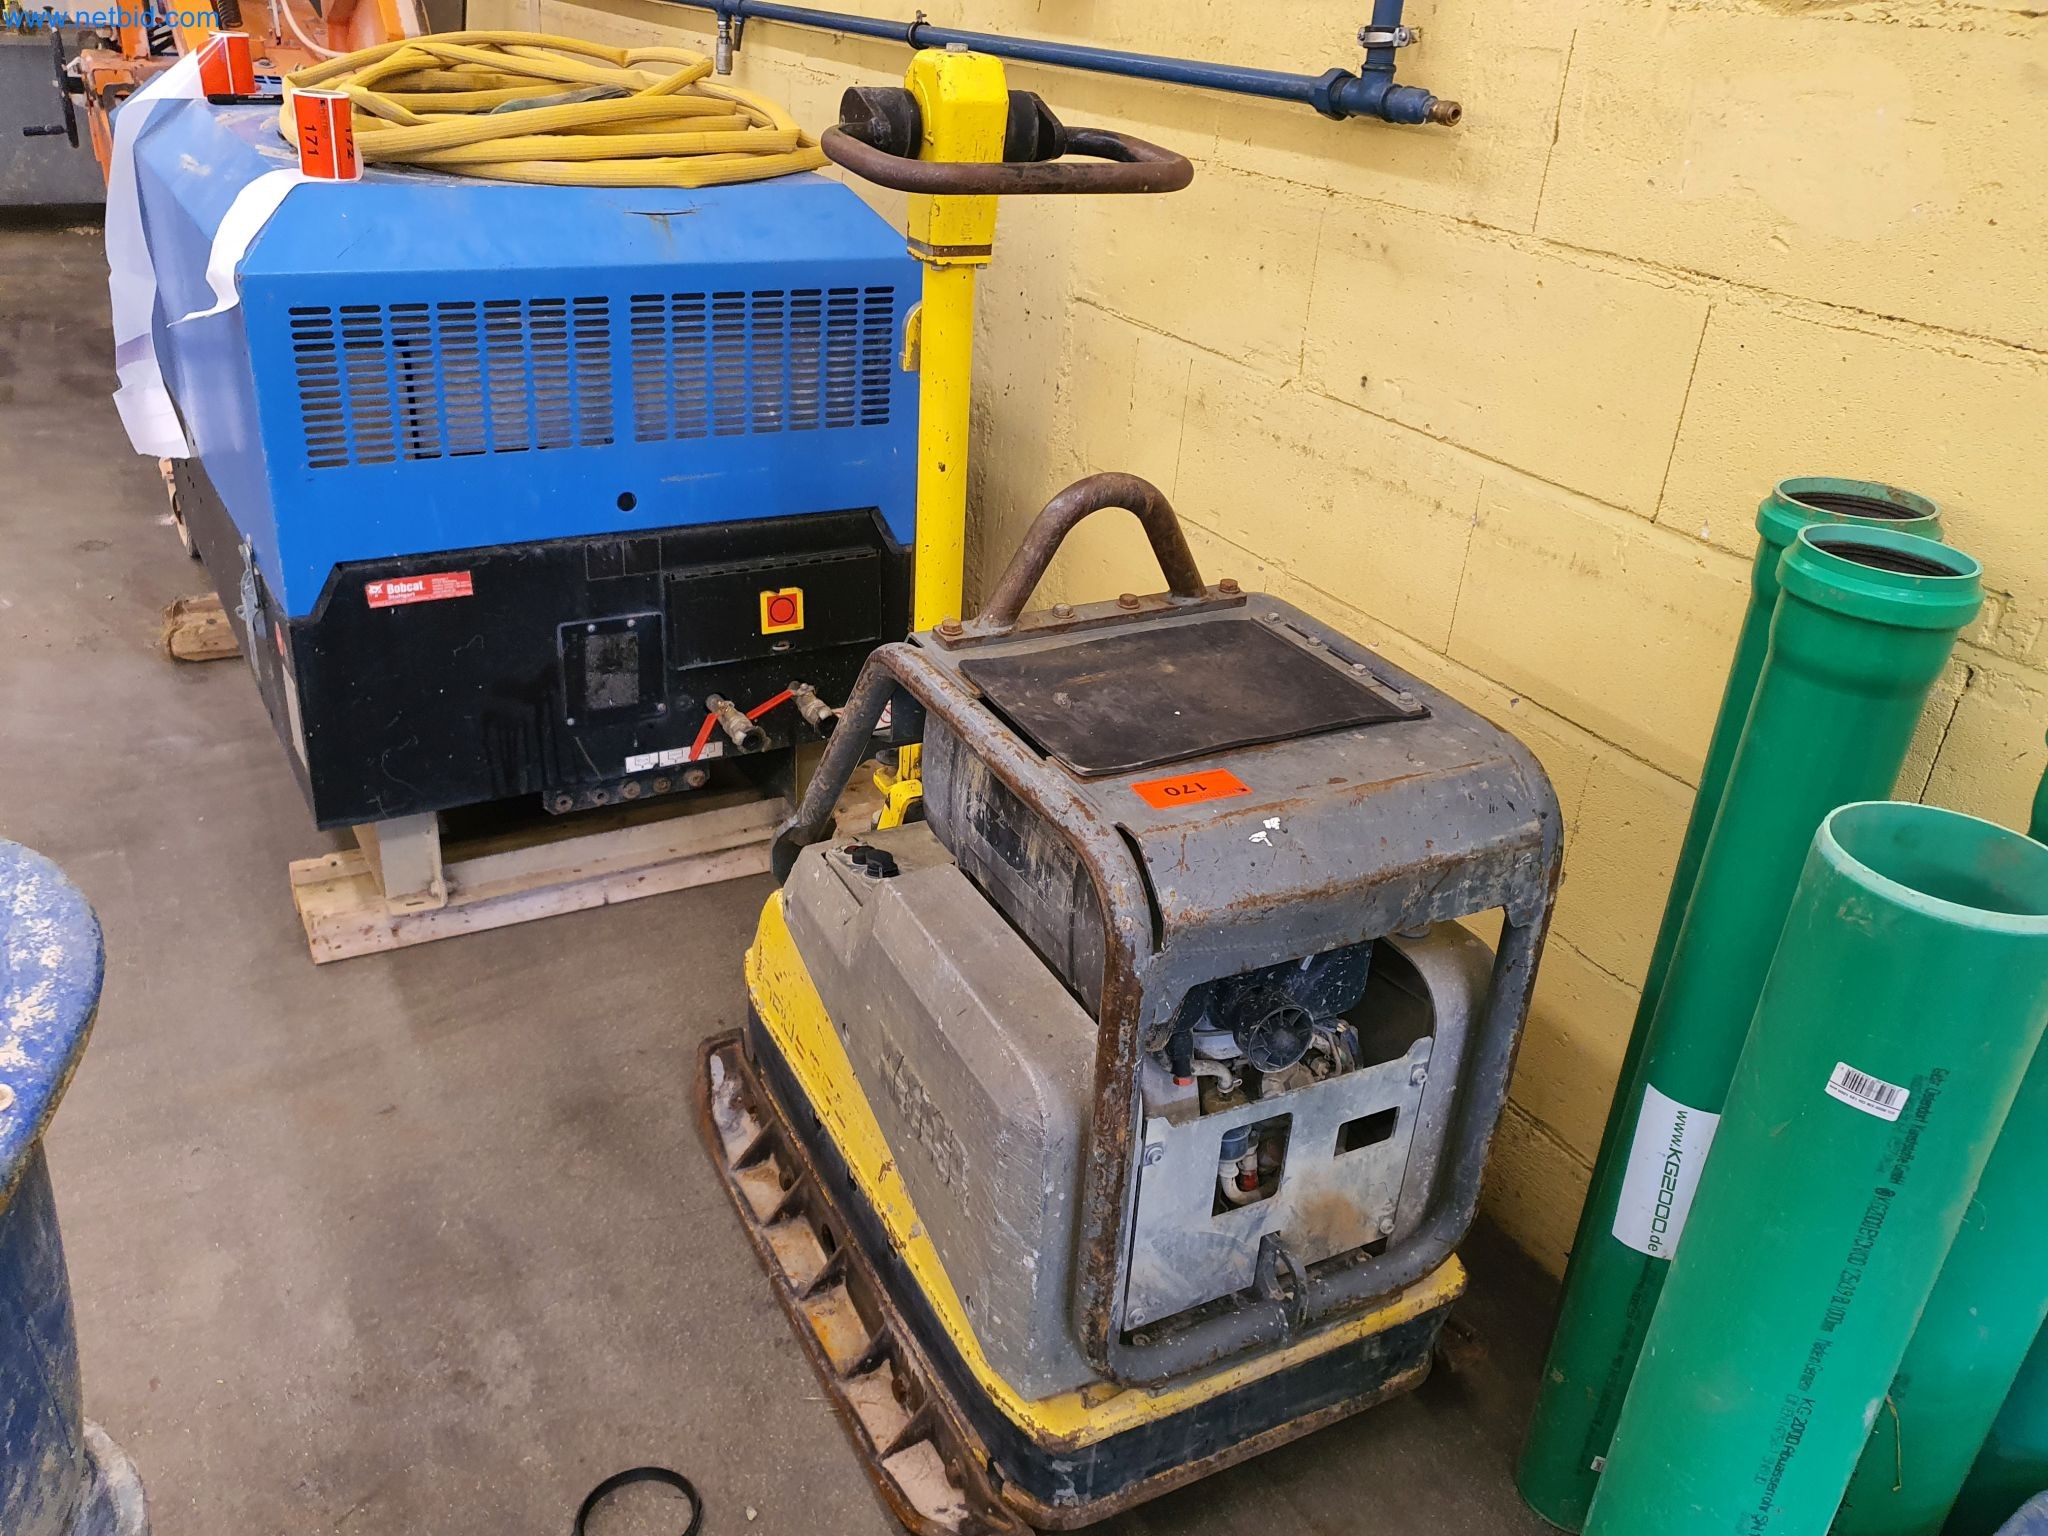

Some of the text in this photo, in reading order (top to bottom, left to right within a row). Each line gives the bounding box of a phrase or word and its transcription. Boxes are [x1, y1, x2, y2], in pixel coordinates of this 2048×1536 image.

[304, 124, 319, 156] 171
[386, 580, 424, 595] Bobcat
[1164, 782, 1207, 796] 170
[1648, 1110, 1688, 1252] www.KG2000.de
